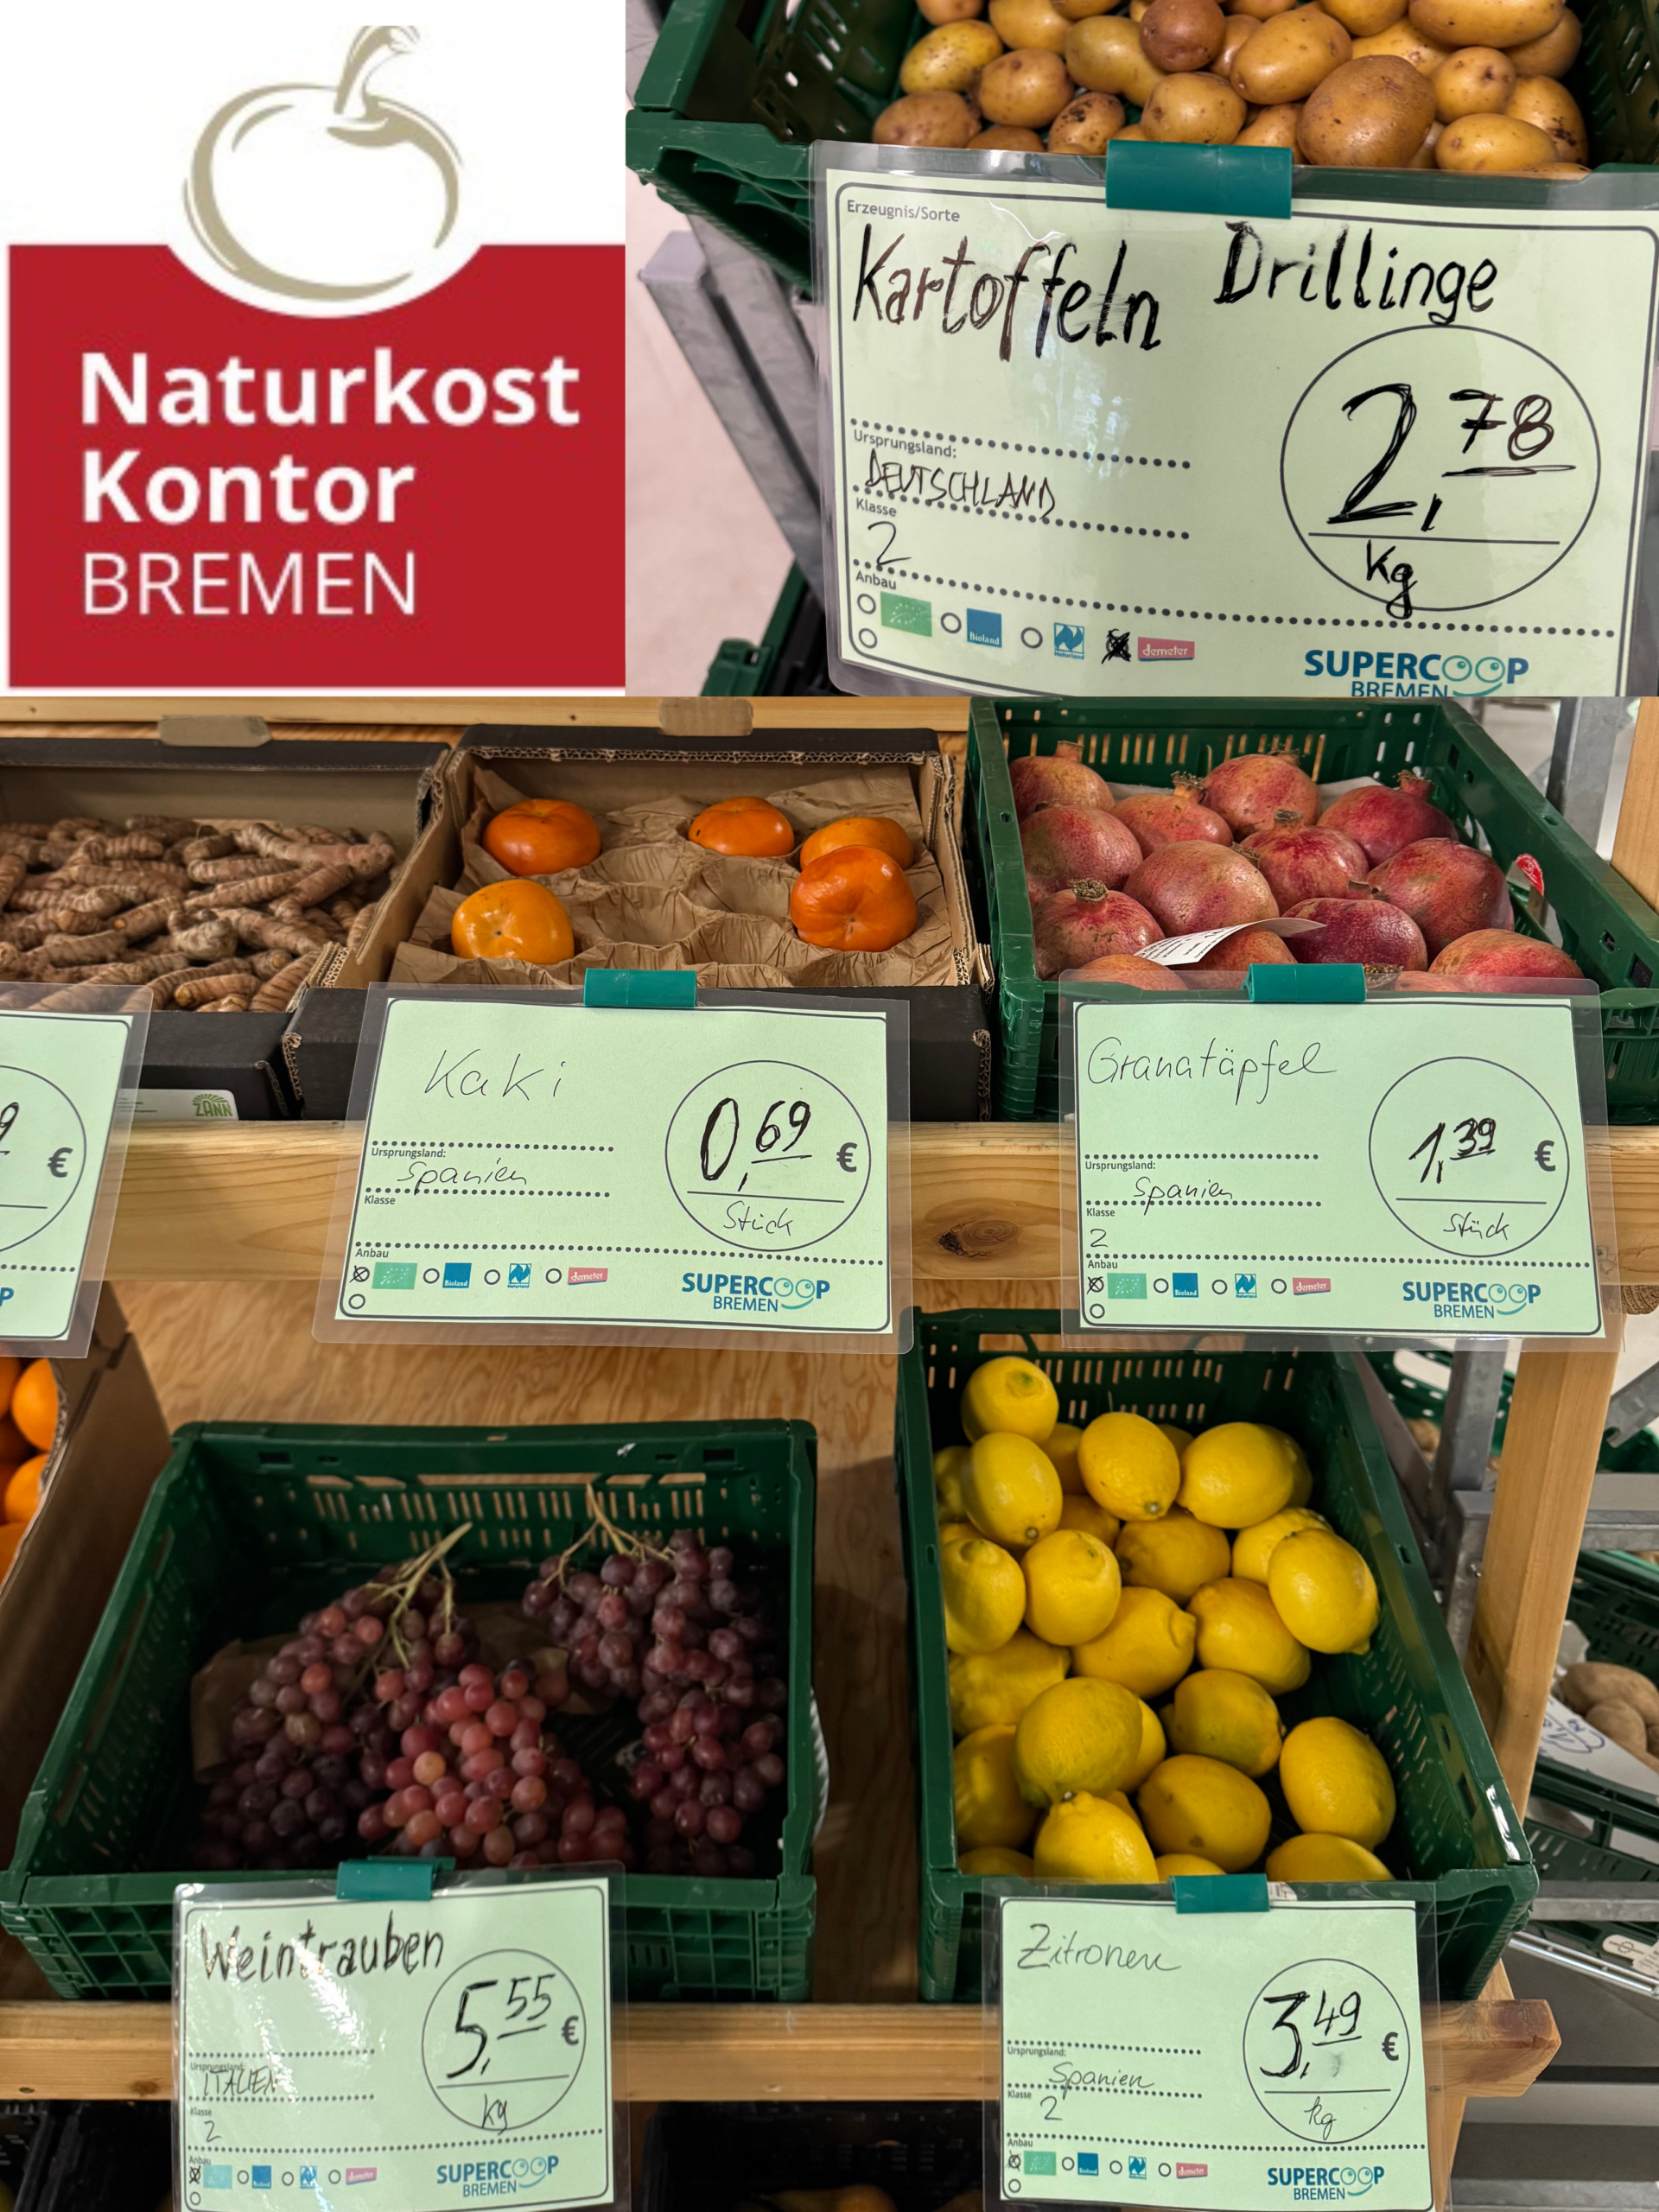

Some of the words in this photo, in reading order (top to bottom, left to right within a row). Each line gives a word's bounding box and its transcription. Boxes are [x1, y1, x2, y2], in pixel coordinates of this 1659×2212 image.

[847, 199, 961, 222] Erzeugnis/Sorte
[853, 223, 1161, 362] Kartoffeln
[1214, 221, 1497, 326] Drillinge
[854, 429, 957, 458] Ursprungsland:
[865, 448, 1055, 519] DEUTSCHLAND
[855, 498, 897, 517] Klasse
[868, 521, 912, 565] 2
[855, 570, 897, 590] Anbau
[969, 632, 1001, 645] Bioland
[1053, 651, 1085, 660] Naturland
[1141, 643, 1188, 657] demeter
[1304, 649, 1529, 684] SUPERCOOP
[424, 1048, 566, 1101] Kaki
[1087, 1037, 1337, 1105] Granatäpfel
[193, 1100, 233, 1117] ZANN
[371, 1147, 447, 1159] Ursprungsland:
[836, 1142, 858, 1173] €
[1534, 1140, 1556, 1172] €
[1085, 1160, 1156, 1172] Ursprungsland:
[397, 1158, 526, 1195] Spanien
[364, 1195, 396, 1205] Klasse
[1134, 1176, 1232, 1216] Spanien
[1086, 1208, 1116, 1217] Klasse
[1443, 1212, 1510, 1240] Stück
[1090, 1229, 1108, 1248] 2
[355, 1249, 389, 1258] Anbau
[1088, 1260, 1118, 1269] Anbau
[444, 1279, 468, 1287] Bioland
[570, 1272, 604, 1281] demeter
[682, 1273, 830, 1299] SUPERCOOP
[1296, 1281, 1327, 1292] demeter
[1402, 1281, 1541, 1303] SUPERCOOP
[713, 1296, 779, 1312] BREMEN
[1433, 1305, 1495, 1319] BREMEN
[200, 1910, 444, 1982] Weintrauben
[1017, 1923, 1181, 1971] Zitronen
[562, 2016, 579, 2045] €
[1007, 2046, 1066, 2057] Ursprungsland:
[1382, 2031, 1399, 2061] €
[1049, 2062, 1155, 2100] Spanien
[1007, 2090, 1032, 2100] Klasse
[190, 2107, 213, 2117] Klasse
[1040, 2096, 1063, 2120] 2
[204, 2120, 222, 2142] 2
[1007, 2139, 1033, 2148] Anbau
[189, 2156, 212, 2165] Anbau
[437, 2155, 559, 2184] SUPERCOOP
[1268, 2166, 1385, 2186] SUPERCOOP
[463, 2180, 517, 2197] BREMEN
[1294, 2188, 1345, 2201] BREMEN
